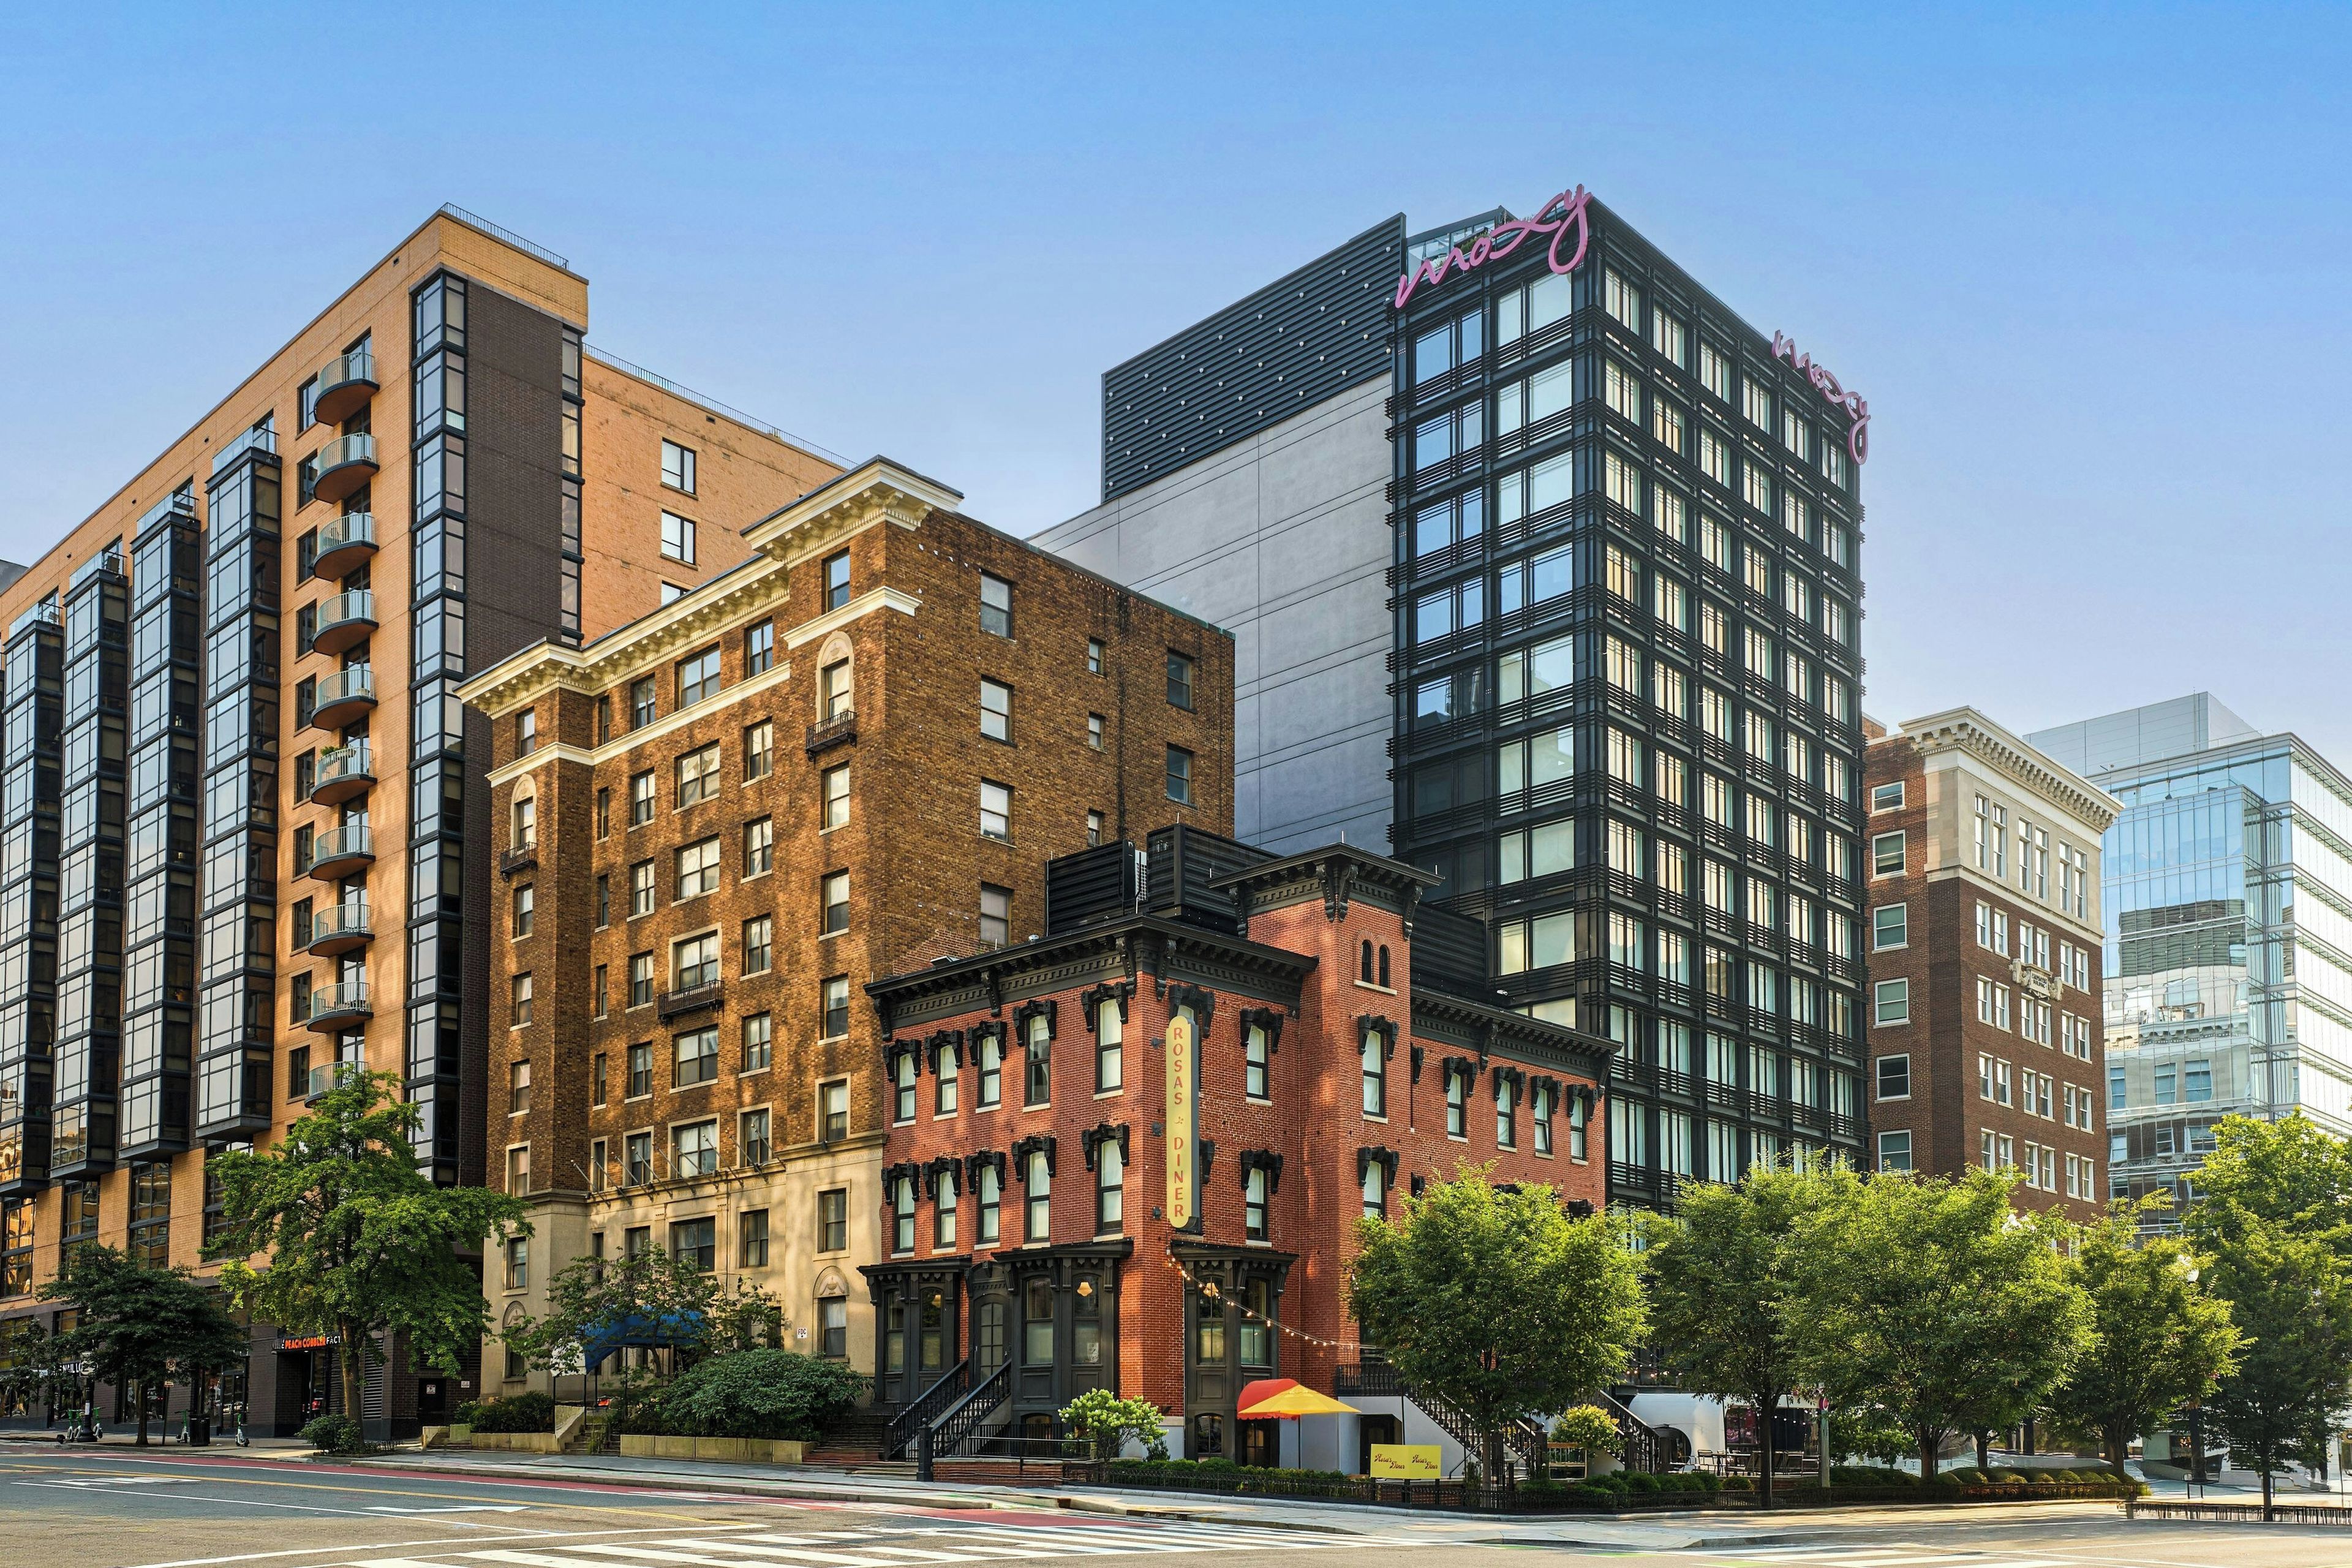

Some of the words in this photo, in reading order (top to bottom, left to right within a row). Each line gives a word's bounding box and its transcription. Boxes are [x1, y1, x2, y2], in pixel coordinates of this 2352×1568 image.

[1395, 184, 1592, 308] moxy
[1772, 330, 1871, 465] moxy
[1173, 1027, 1183, 1105] ROSAS
[1174, 1137, 1183, 1217] DINER
[285, 1340, 302, 1349] PEACH
[303, 1336, 326, 1348] COBBLER
[62, 1363, 75, 1373] NAIL
[1374, 1453, 1392, 1463] Rosa's
[1412, 1454, 1427, 1463] Rosa's
[1389, 1461, 1405, 1469] Diner
